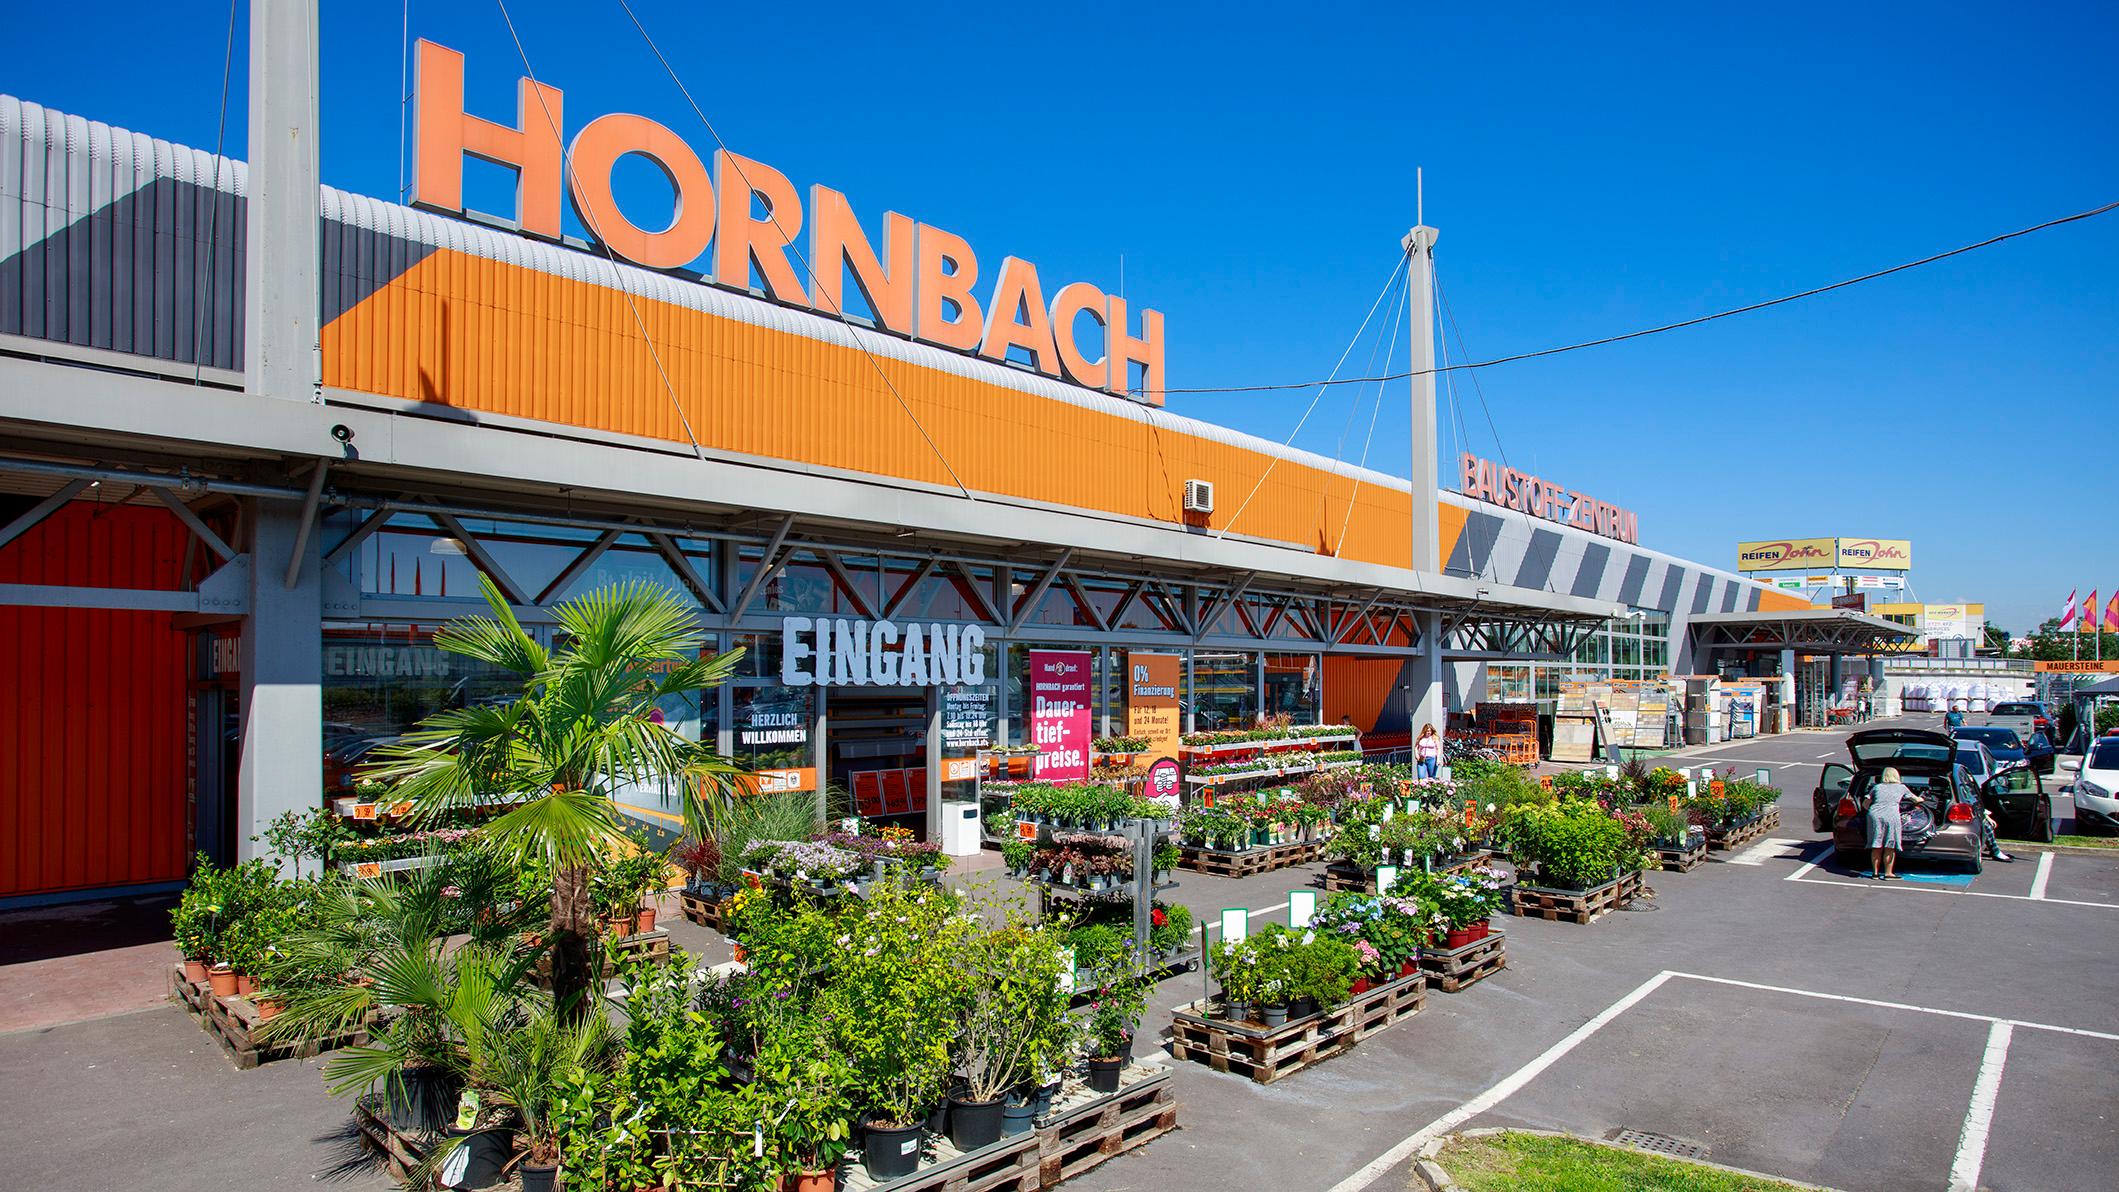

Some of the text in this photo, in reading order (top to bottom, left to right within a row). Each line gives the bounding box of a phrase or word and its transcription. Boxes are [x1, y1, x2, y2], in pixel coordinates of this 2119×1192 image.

[412, 37, 1165, 407] HORNBACH
[1461, 451, 1639, 545] BAUSTOFF-ZENTRUM
[1741, 551, 1779, 561] REIFEN
[1842, 548, 1871, 557] REIFEN
[326, 646, 449, 676] EINGANG
[782, 616, 985, 687] EINGANG
[1133, 664, 1149, 683] 0%
[2046, 662, 2104, 671] MAUERSTEINE
[1062, 682, 1085, 693] garantiert
[1133, 684, 1175, 698] Finanzierung
[1035, 696, 1085, 719] Dauer-
[751, 713, 798, 727] HERZLICH
[742, 730, 807, 745] WILLKOMMEN
[1035, 720, 1070, 744] tief-
[1035, 746, 1085, 775] preise.
